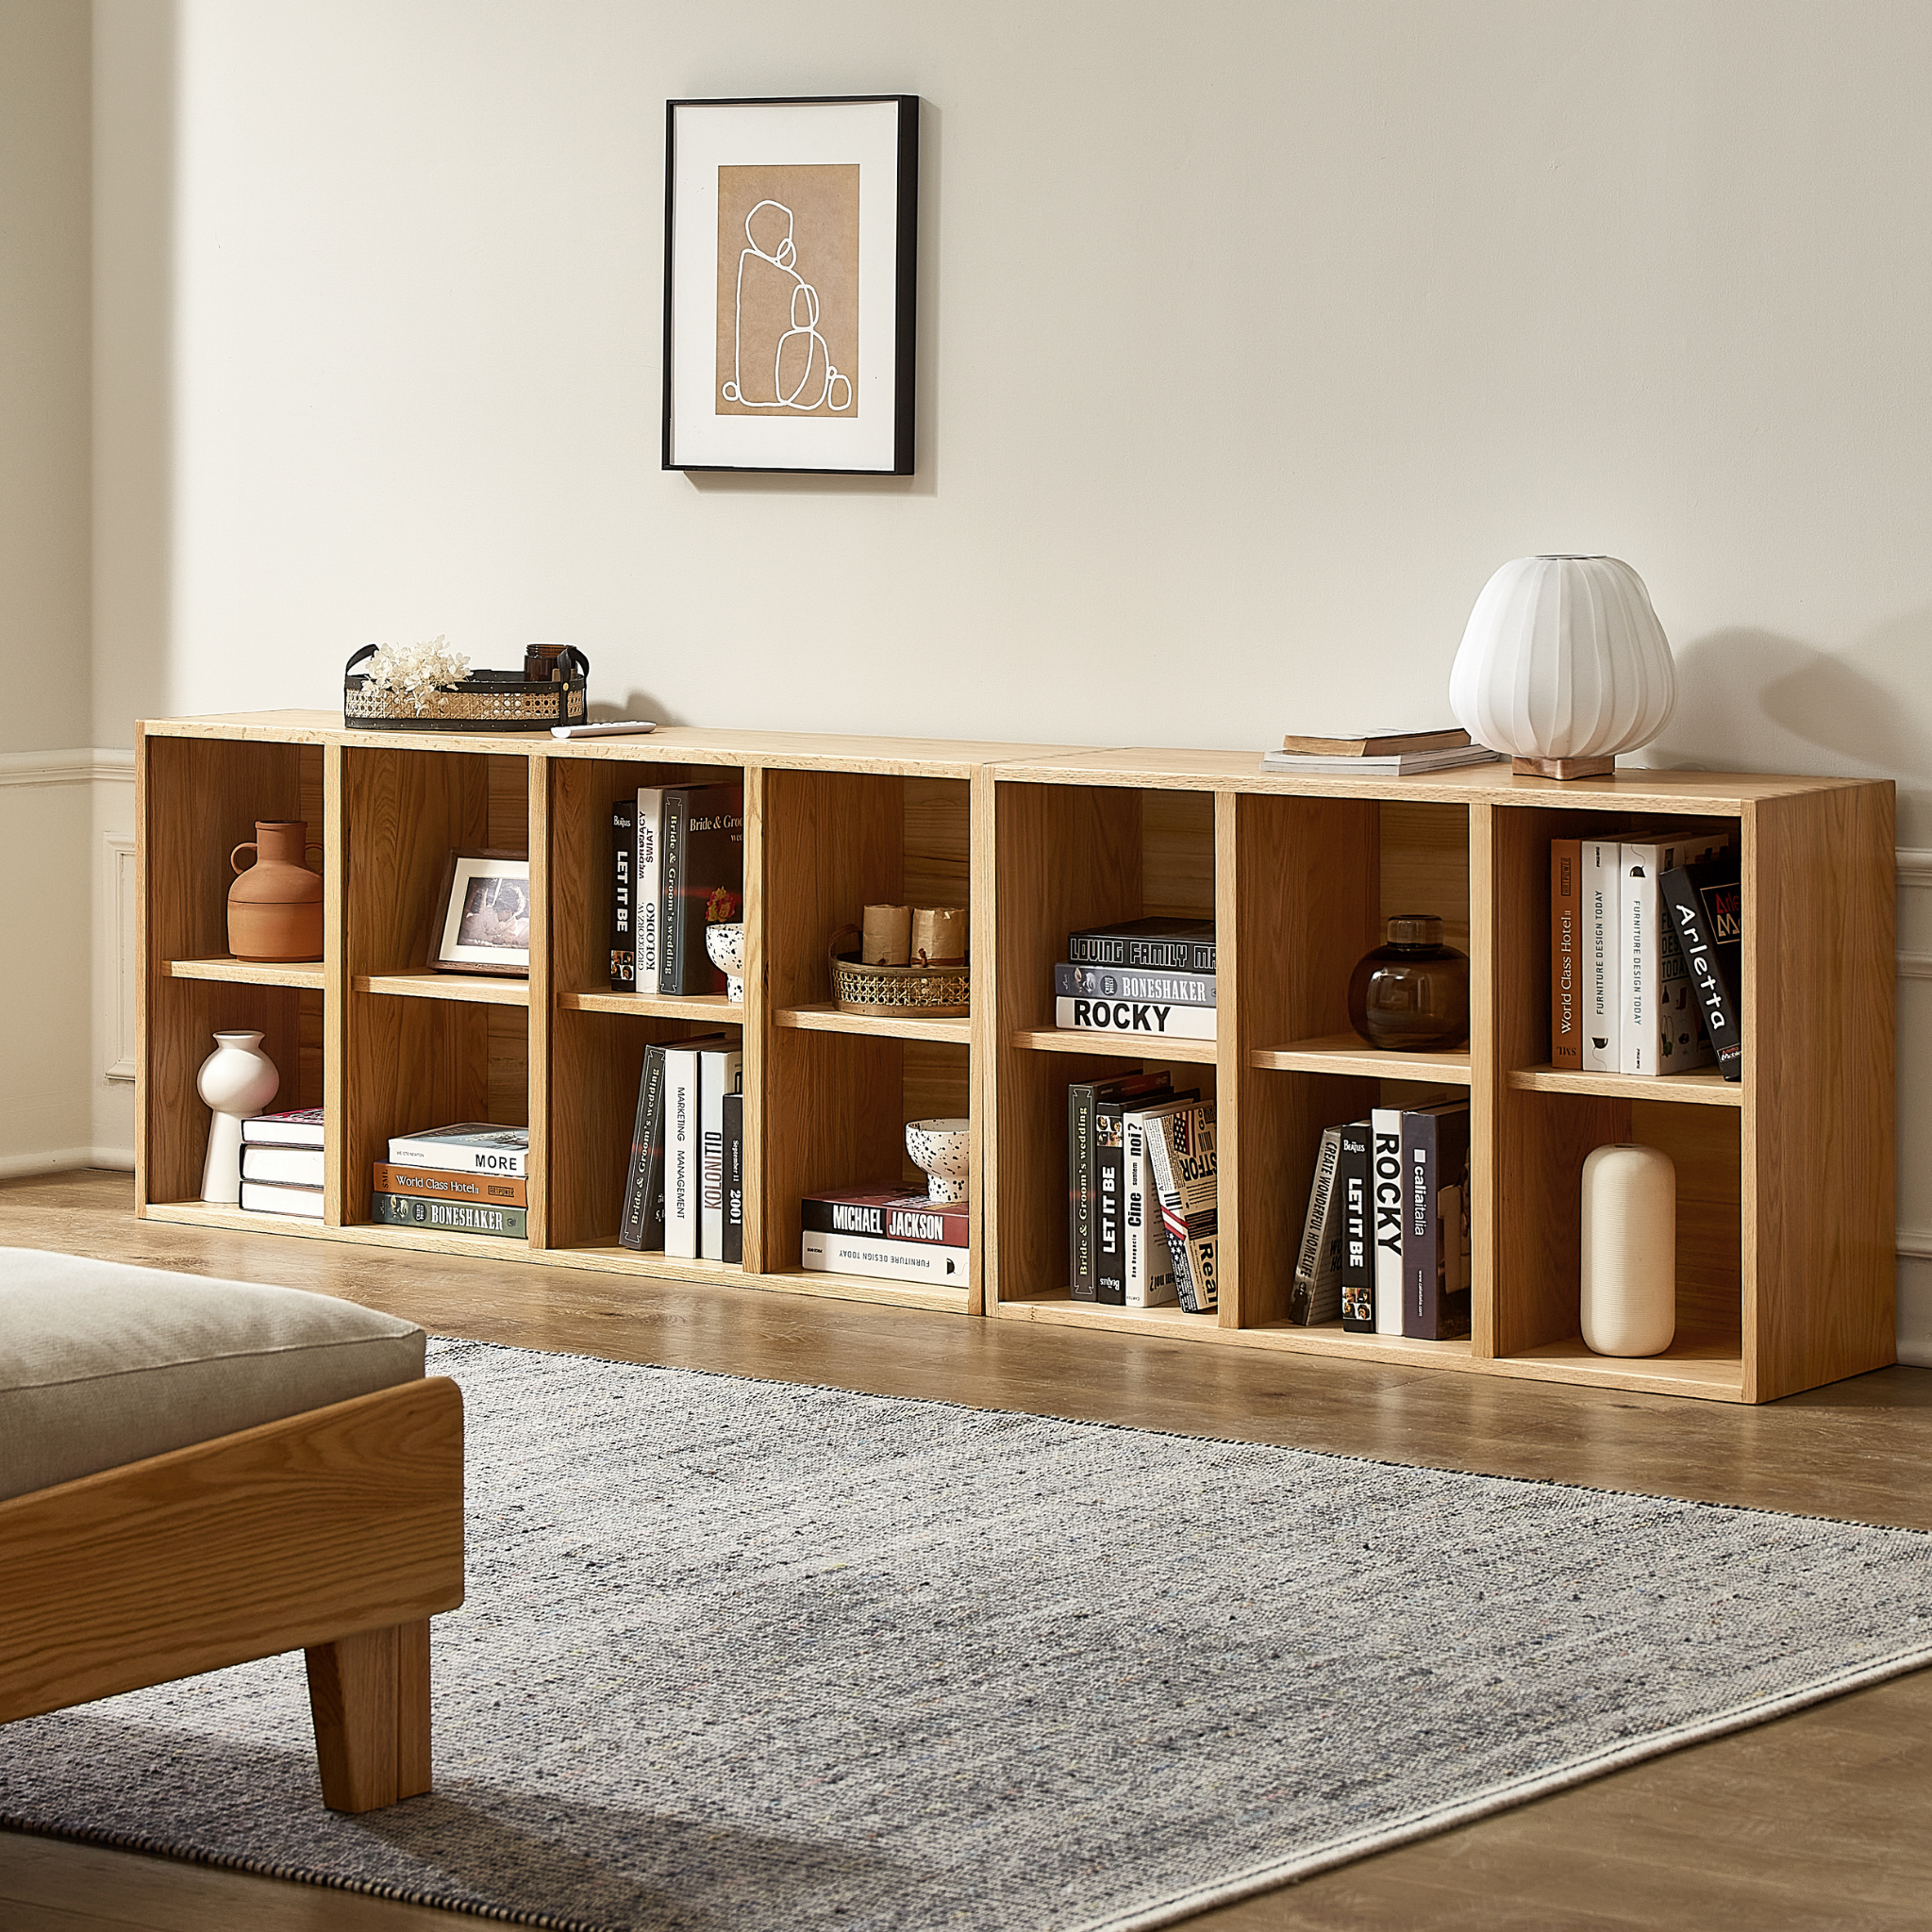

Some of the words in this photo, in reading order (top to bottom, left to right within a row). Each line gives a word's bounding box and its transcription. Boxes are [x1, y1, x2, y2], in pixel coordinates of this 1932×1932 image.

[690, 817, 712, 831] Bride
[713, 815, 722, 829] &
[724, 814, 743, 828] Groo
[616, 850, 628, 885] LET
[668, 853, 676, 864] &
[616, 888, 628, 906] IT
[666, 867, 676, 924] Groom's
[1716, 891, 1740, 914] Arle
[616, 908, 628, 933] BE
[646, 902, 656, 971] KOŁODKO
[664, 924, 674, 975] wedding
[1070, 938, 1124, 964] LOVING
[1130, 941, 1187, 968] FAMILY
[1193, 945, 1217, 970] MA
[1661, 936, 1680, 955] DES
[1561, 956, 1572, 990] Class
[1661, 958, 1685, 979] TODA
[1675, 904, 1725, 1030] Arletta
[1122, 976, 1207, 1002] BONESHAKER
[1074, 999, 1172, 1033] ROCKY
[1561, 993, 1572, 1034] World
[645, 1068, 660, 1117] wedding
[676, 1087, 686, 1141] MARKETING
[638, 1119, 652, 1174] Groom's
[1078, 1107, 1088, 1159] wedding
[1127, 1123, 1142, 1157] noi?
[475, 1154, 517, 1171] MORE
[731, 1140, 740, 1174] September
[1321, 1141, 1338, 1175] CREATE
[396, 1174, 424, 1189] World
[425, 1178, 448, 1191] Class
[636, 1176, 644, 1189] &
[676, 1150, 686, 1220] MANAGEMENT
[1078, 1167, 1088, 1224] Groom's
[1102, 1166, 1116, 1192] BE
[1375, 1133, 1402, 1257] ROCKY
[631, 1190, 641, 1224] Bride
[730, 1189, 741, 1224] 2001
[1102, 1195, 1116, 1215] IT
[1127, 1192, 1142, 1227] Cine
[1310, 1175, 1330, 1230] WONDERFUL
[1348, 1178, 1363, 1215] LET
[1414, 1166, 1427, 1236] caliaitalia
[430, 1204, 503, 1231] BONESHAKER
[833, 1204, 883, 1235] MICHAEL
[889, 1211, 943, 1241] JACKSON
[1079, 1225, 1088, 1236] &
[1349, 1218, 1363, 1238] IT
[1102, 1217, 1116, 1254] LET
[839, 1249, 861, 1259] TODAY
[862, 1252, 889, 1263] DESIGN
[891, 1256, 930, 1268] FURNITURE
[1079, 1239, 1089, 1275] Bride
[1300, 1231, 1319, 1278] HOMELIFE
[1349, 1241, 1364, 1268] BE
[1199, 1242, 1218, 1304] Real
